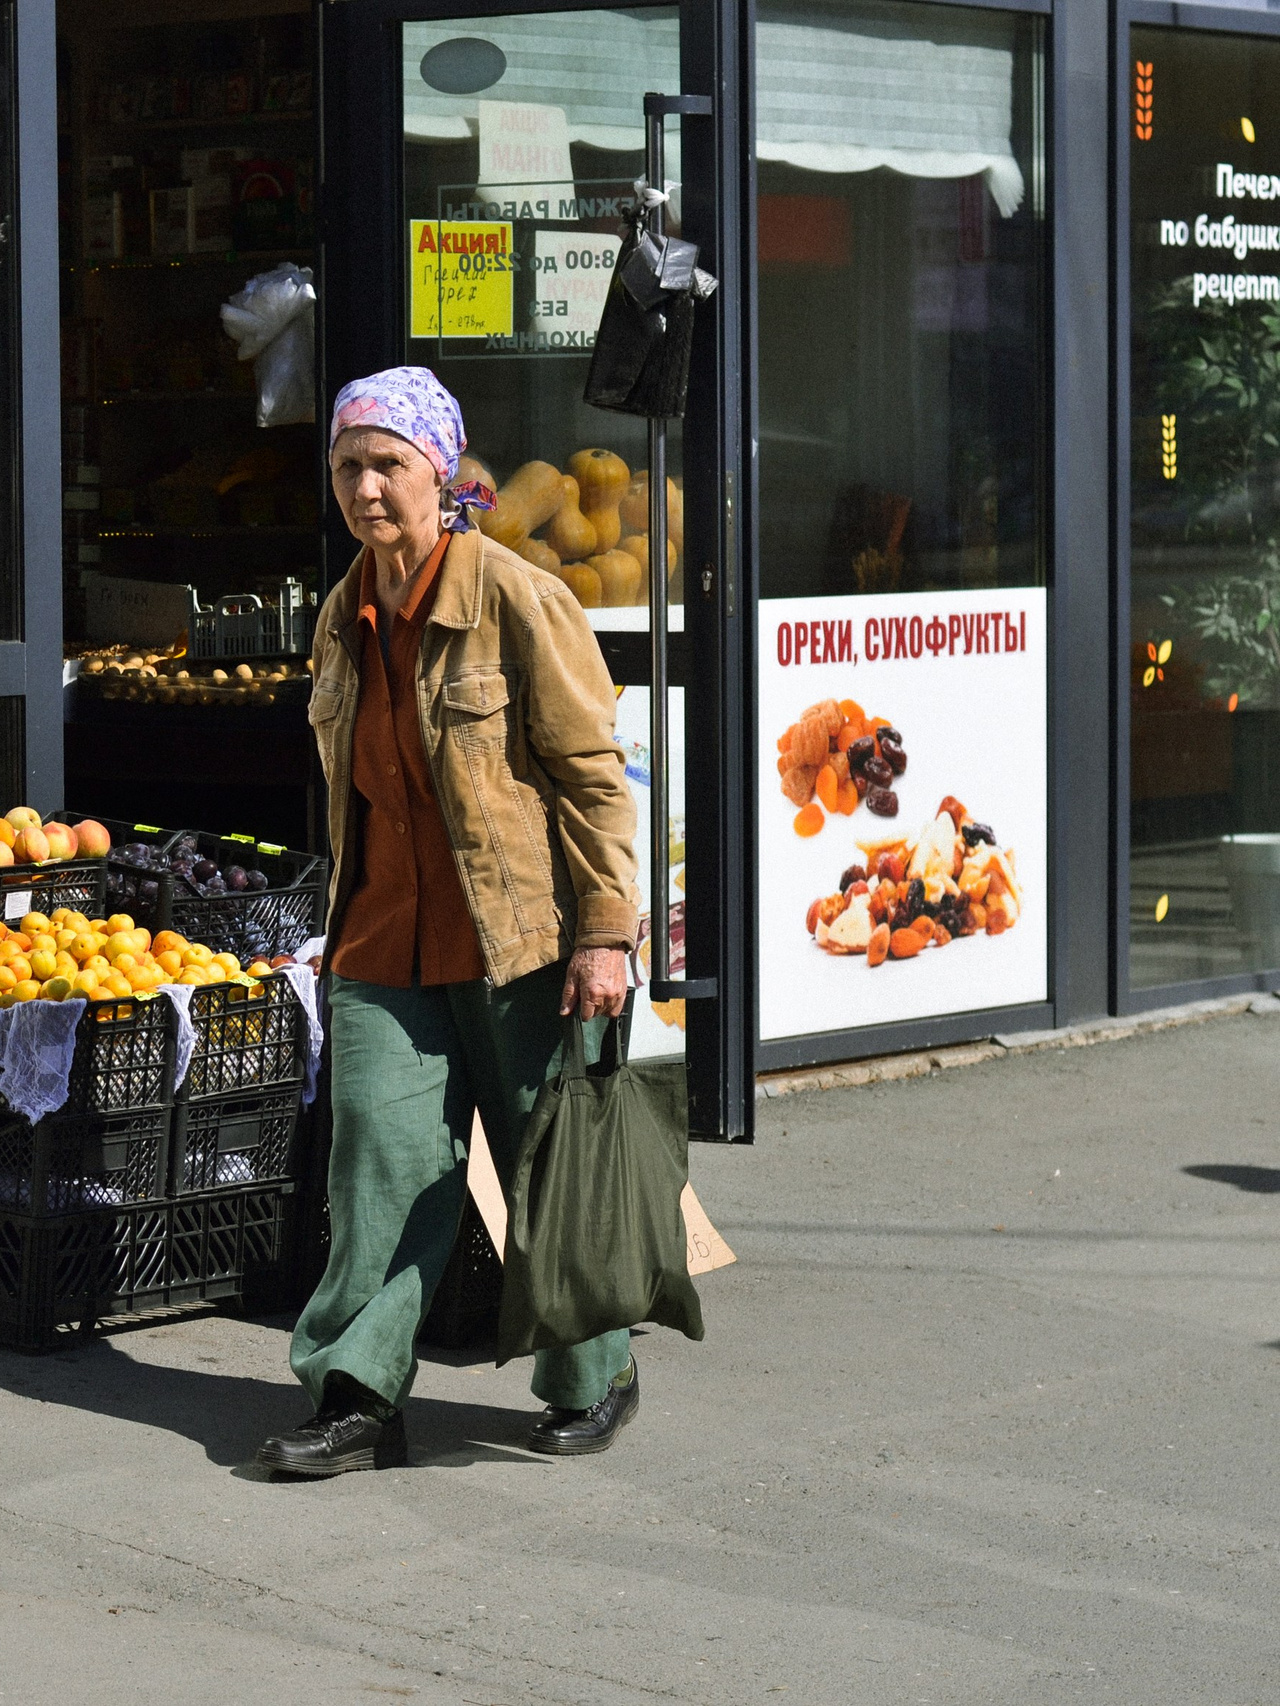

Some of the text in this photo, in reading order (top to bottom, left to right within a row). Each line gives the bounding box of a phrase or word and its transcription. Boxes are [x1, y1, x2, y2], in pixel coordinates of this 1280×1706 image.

[418, 224, 507, 254] Акция!
[1160, 219, 1189, 246] по
[777, 612, 1025, 667] ОРЕХИ, СУХОФРУКТЫ
